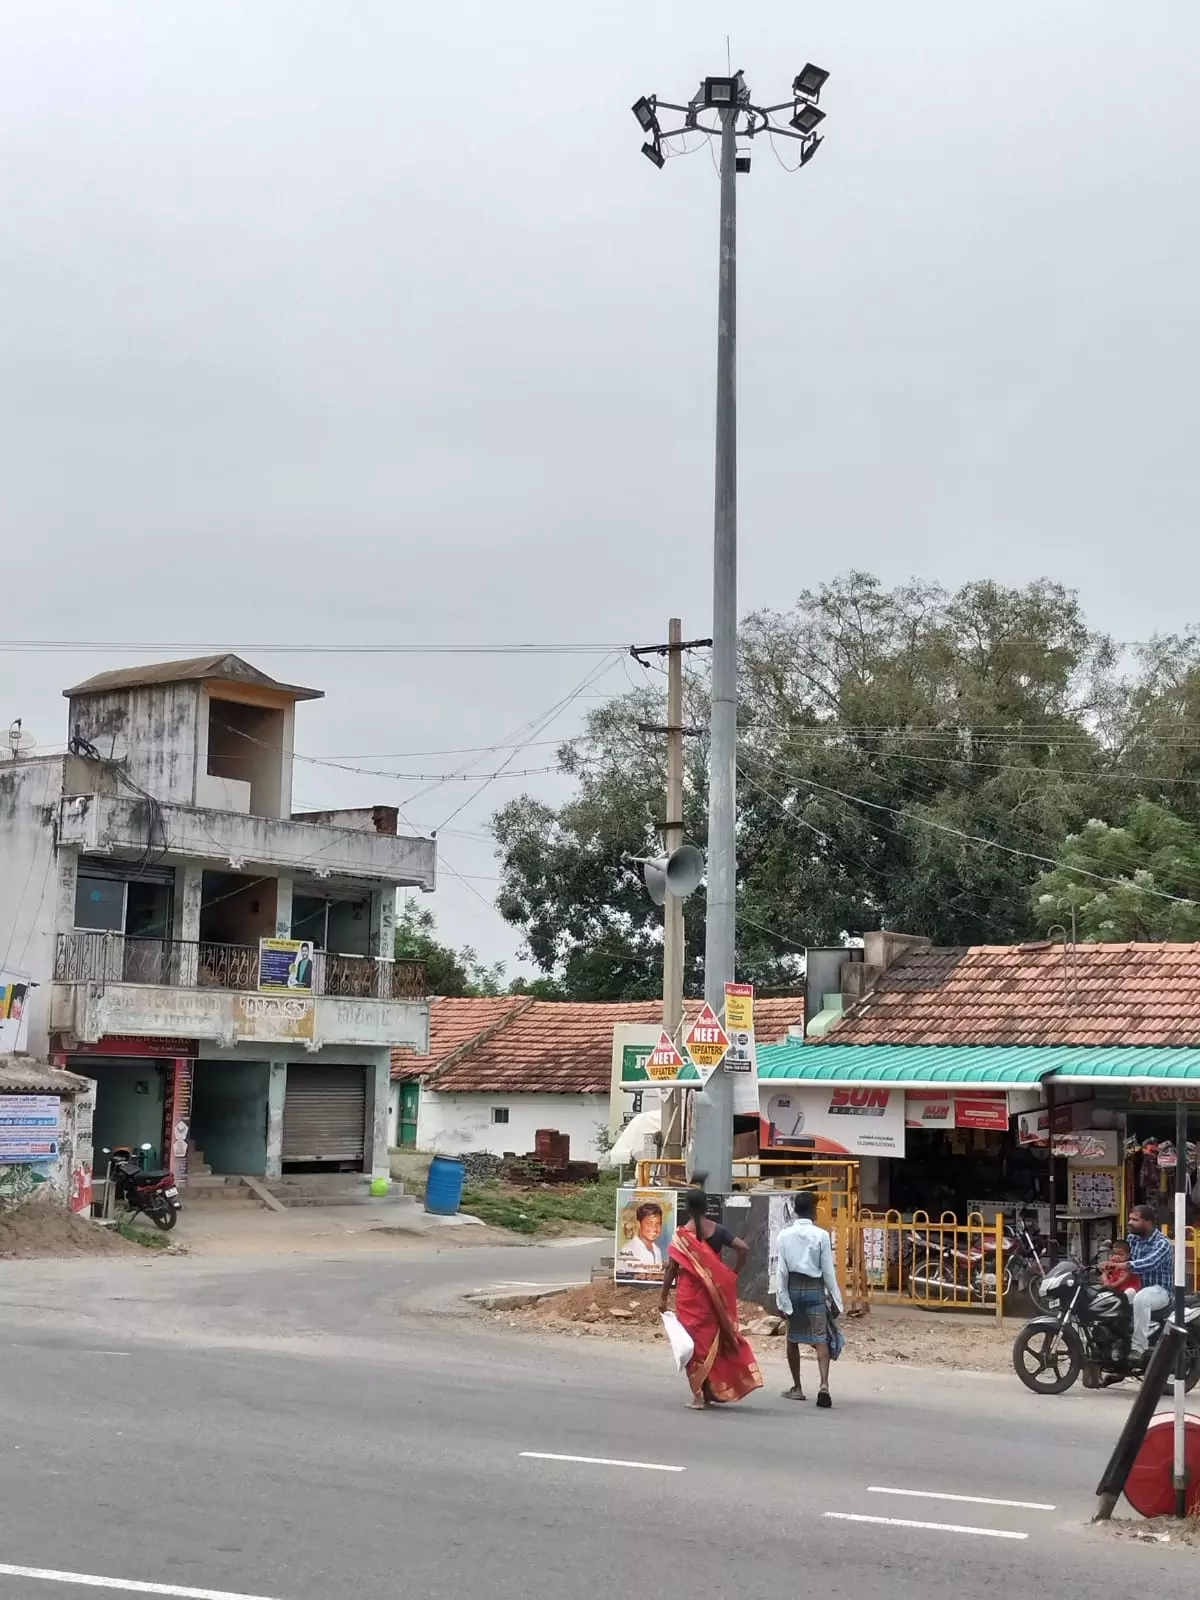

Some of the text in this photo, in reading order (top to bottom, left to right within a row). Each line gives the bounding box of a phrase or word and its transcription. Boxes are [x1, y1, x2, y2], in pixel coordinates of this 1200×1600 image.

[694, 1027, 720, 1042] NEET
[691, 1045, 723, 1055] REPEATERS
[653, 1052, 675, 1064] NEET
[699, 1056, 713, 1065] 2023
[650, 1066, 679, 1076] REPEATERS
[830, 1088, 891, 1107] SUN
